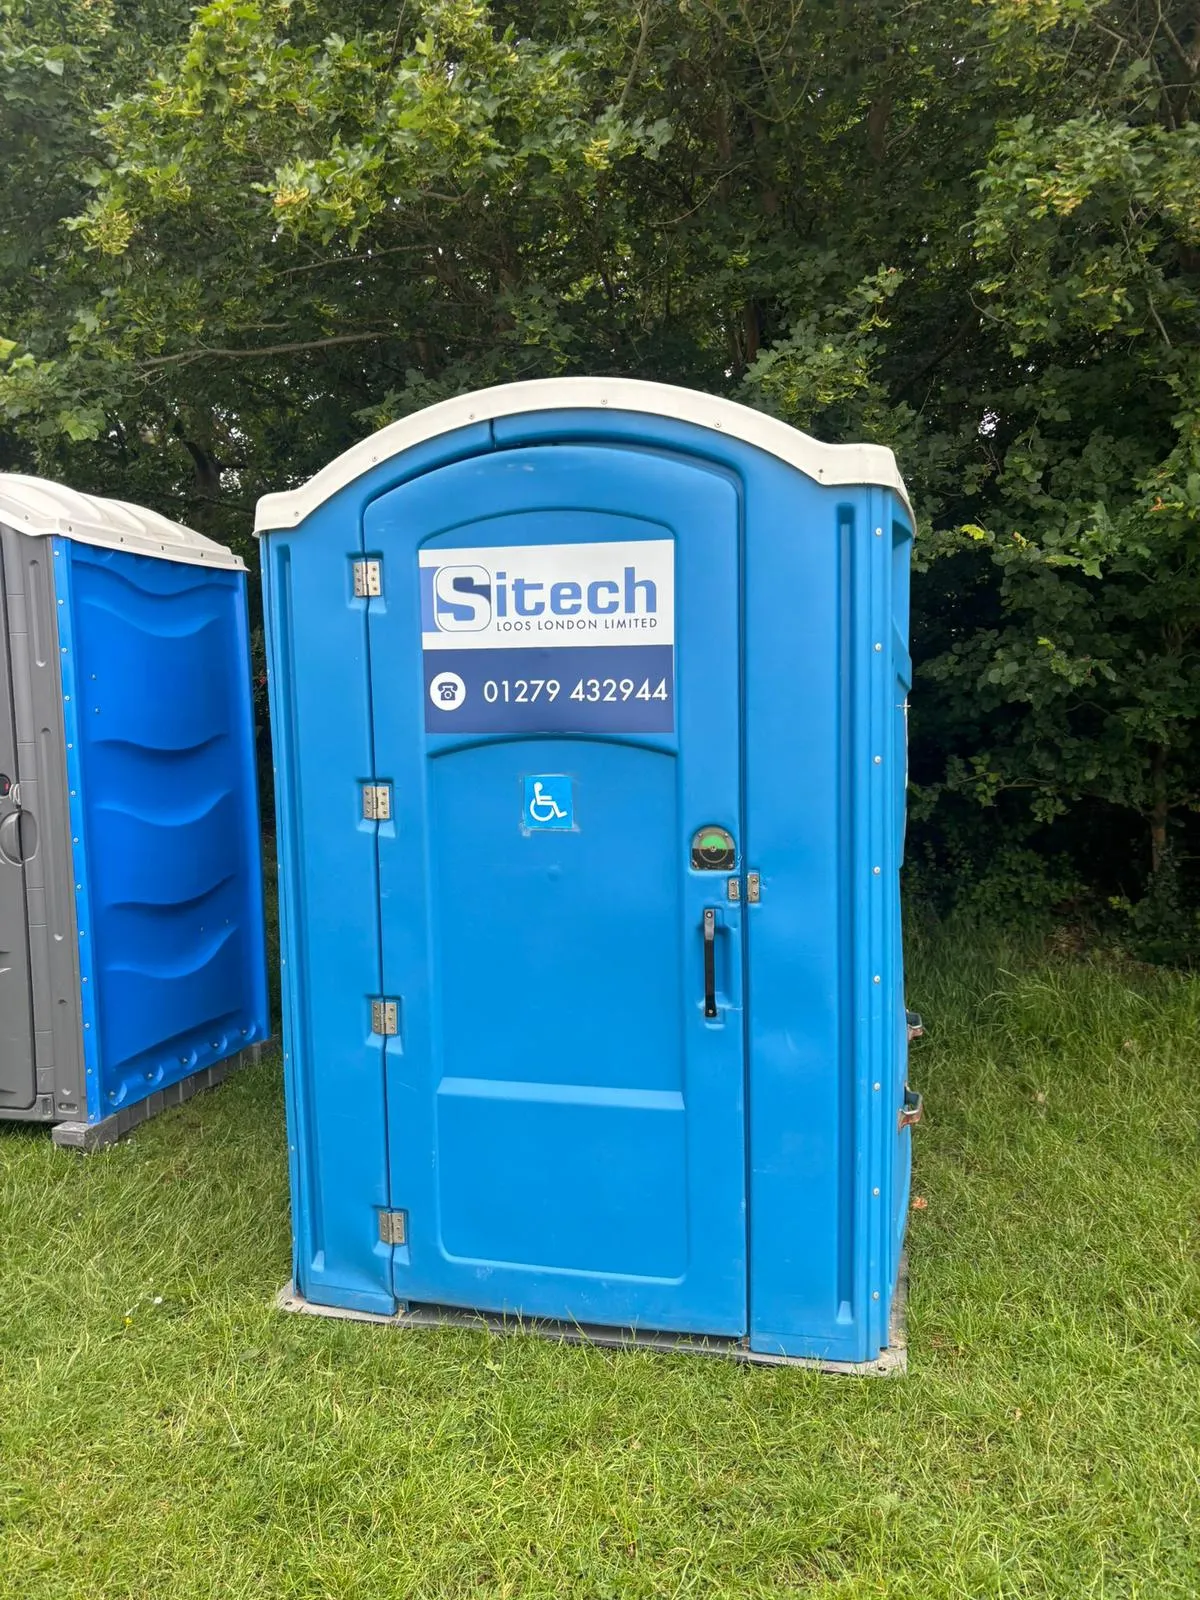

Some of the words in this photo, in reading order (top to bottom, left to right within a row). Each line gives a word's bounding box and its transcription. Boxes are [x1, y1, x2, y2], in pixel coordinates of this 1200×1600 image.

[435, 565, 658, 632] Sitech
[496, 620, 532, 632] LOOS
[537, 619, 598, 631] LONDON
[604, 617, 658, 629] LIMITED
[483, 679, 561, 703] 01279
[569, 677, 668, 702] 432944
